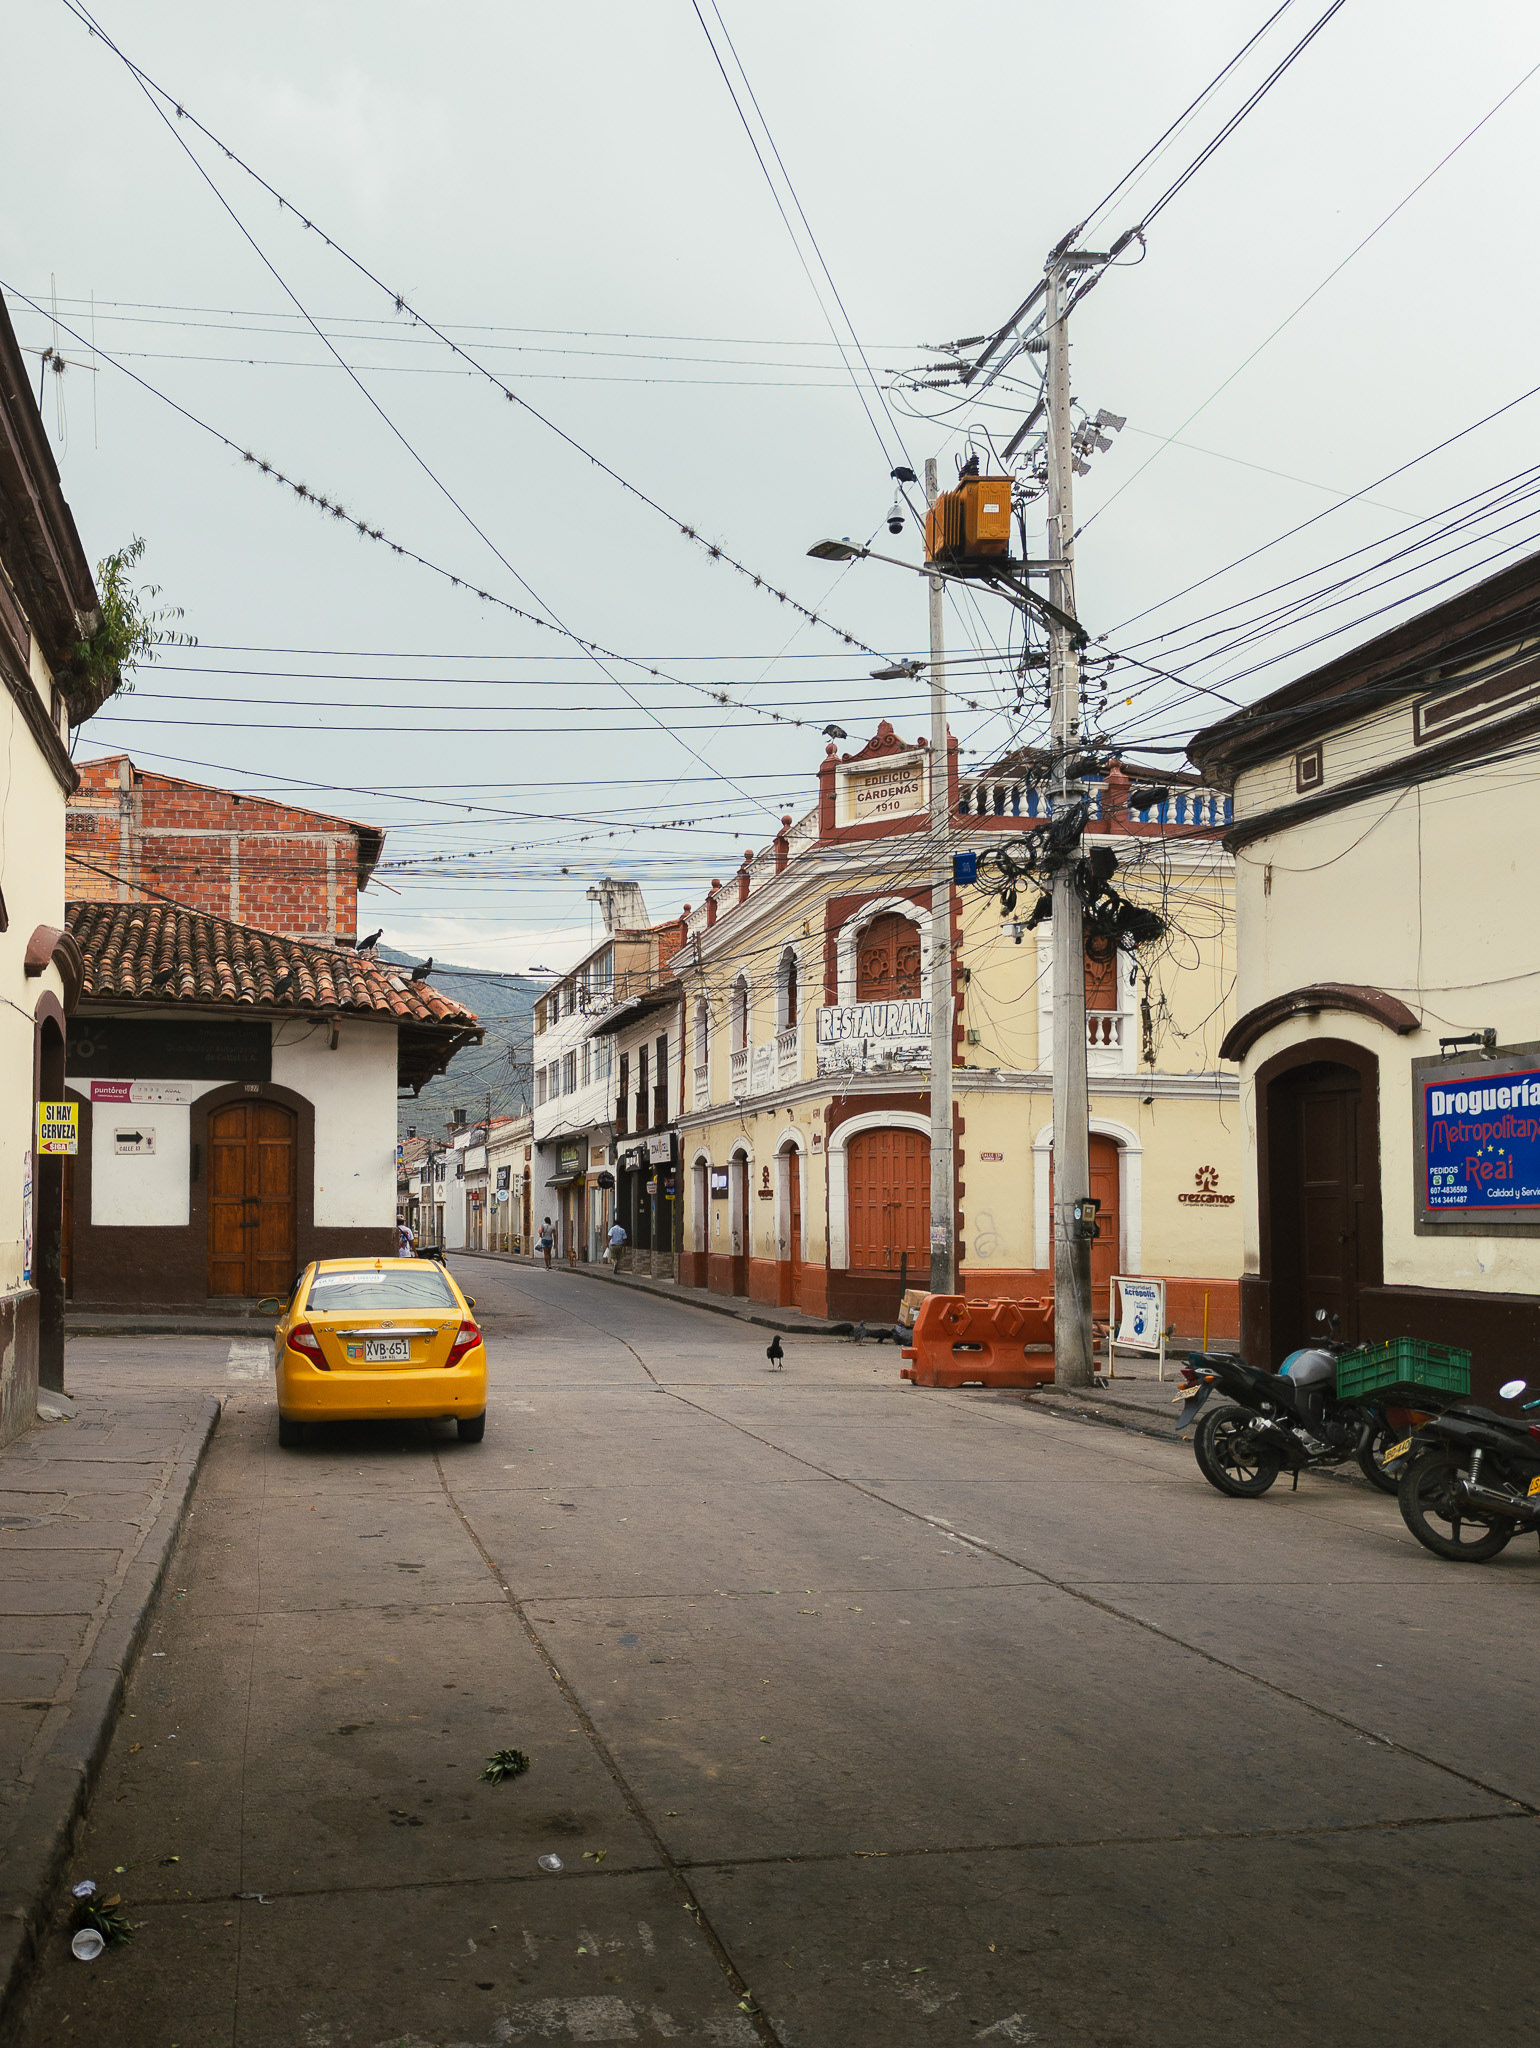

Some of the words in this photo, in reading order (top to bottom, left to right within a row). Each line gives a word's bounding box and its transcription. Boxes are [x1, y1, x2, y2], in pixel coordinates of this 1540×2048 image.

[865, 771, 911, 786] EDIFICIO
[857, 783, 919, 802] CÁRDENAS
[876, 800, 900, 812] 1910
[820, 1001, 932, 1042] RESTAURANT
[1431, 1078, 1540, 1116] Droguería
[46, 1105, 54, 1121] SI
[56, 1105, 72, 1121] HAY
[41, 1123, 76, 1140] CERVEZA
[1431, 1114, 1540, 1152] Metropolitan
[1429, 1166, 1459, 1175] PEDIDOS
[1465, 1154, 1514, 1190] Real
[1178, 1193, 1236, 1204] crezcamos
[1487, 1187, 1514, 1198] Calidad
[1514, 1190, 1520, 1200] y
